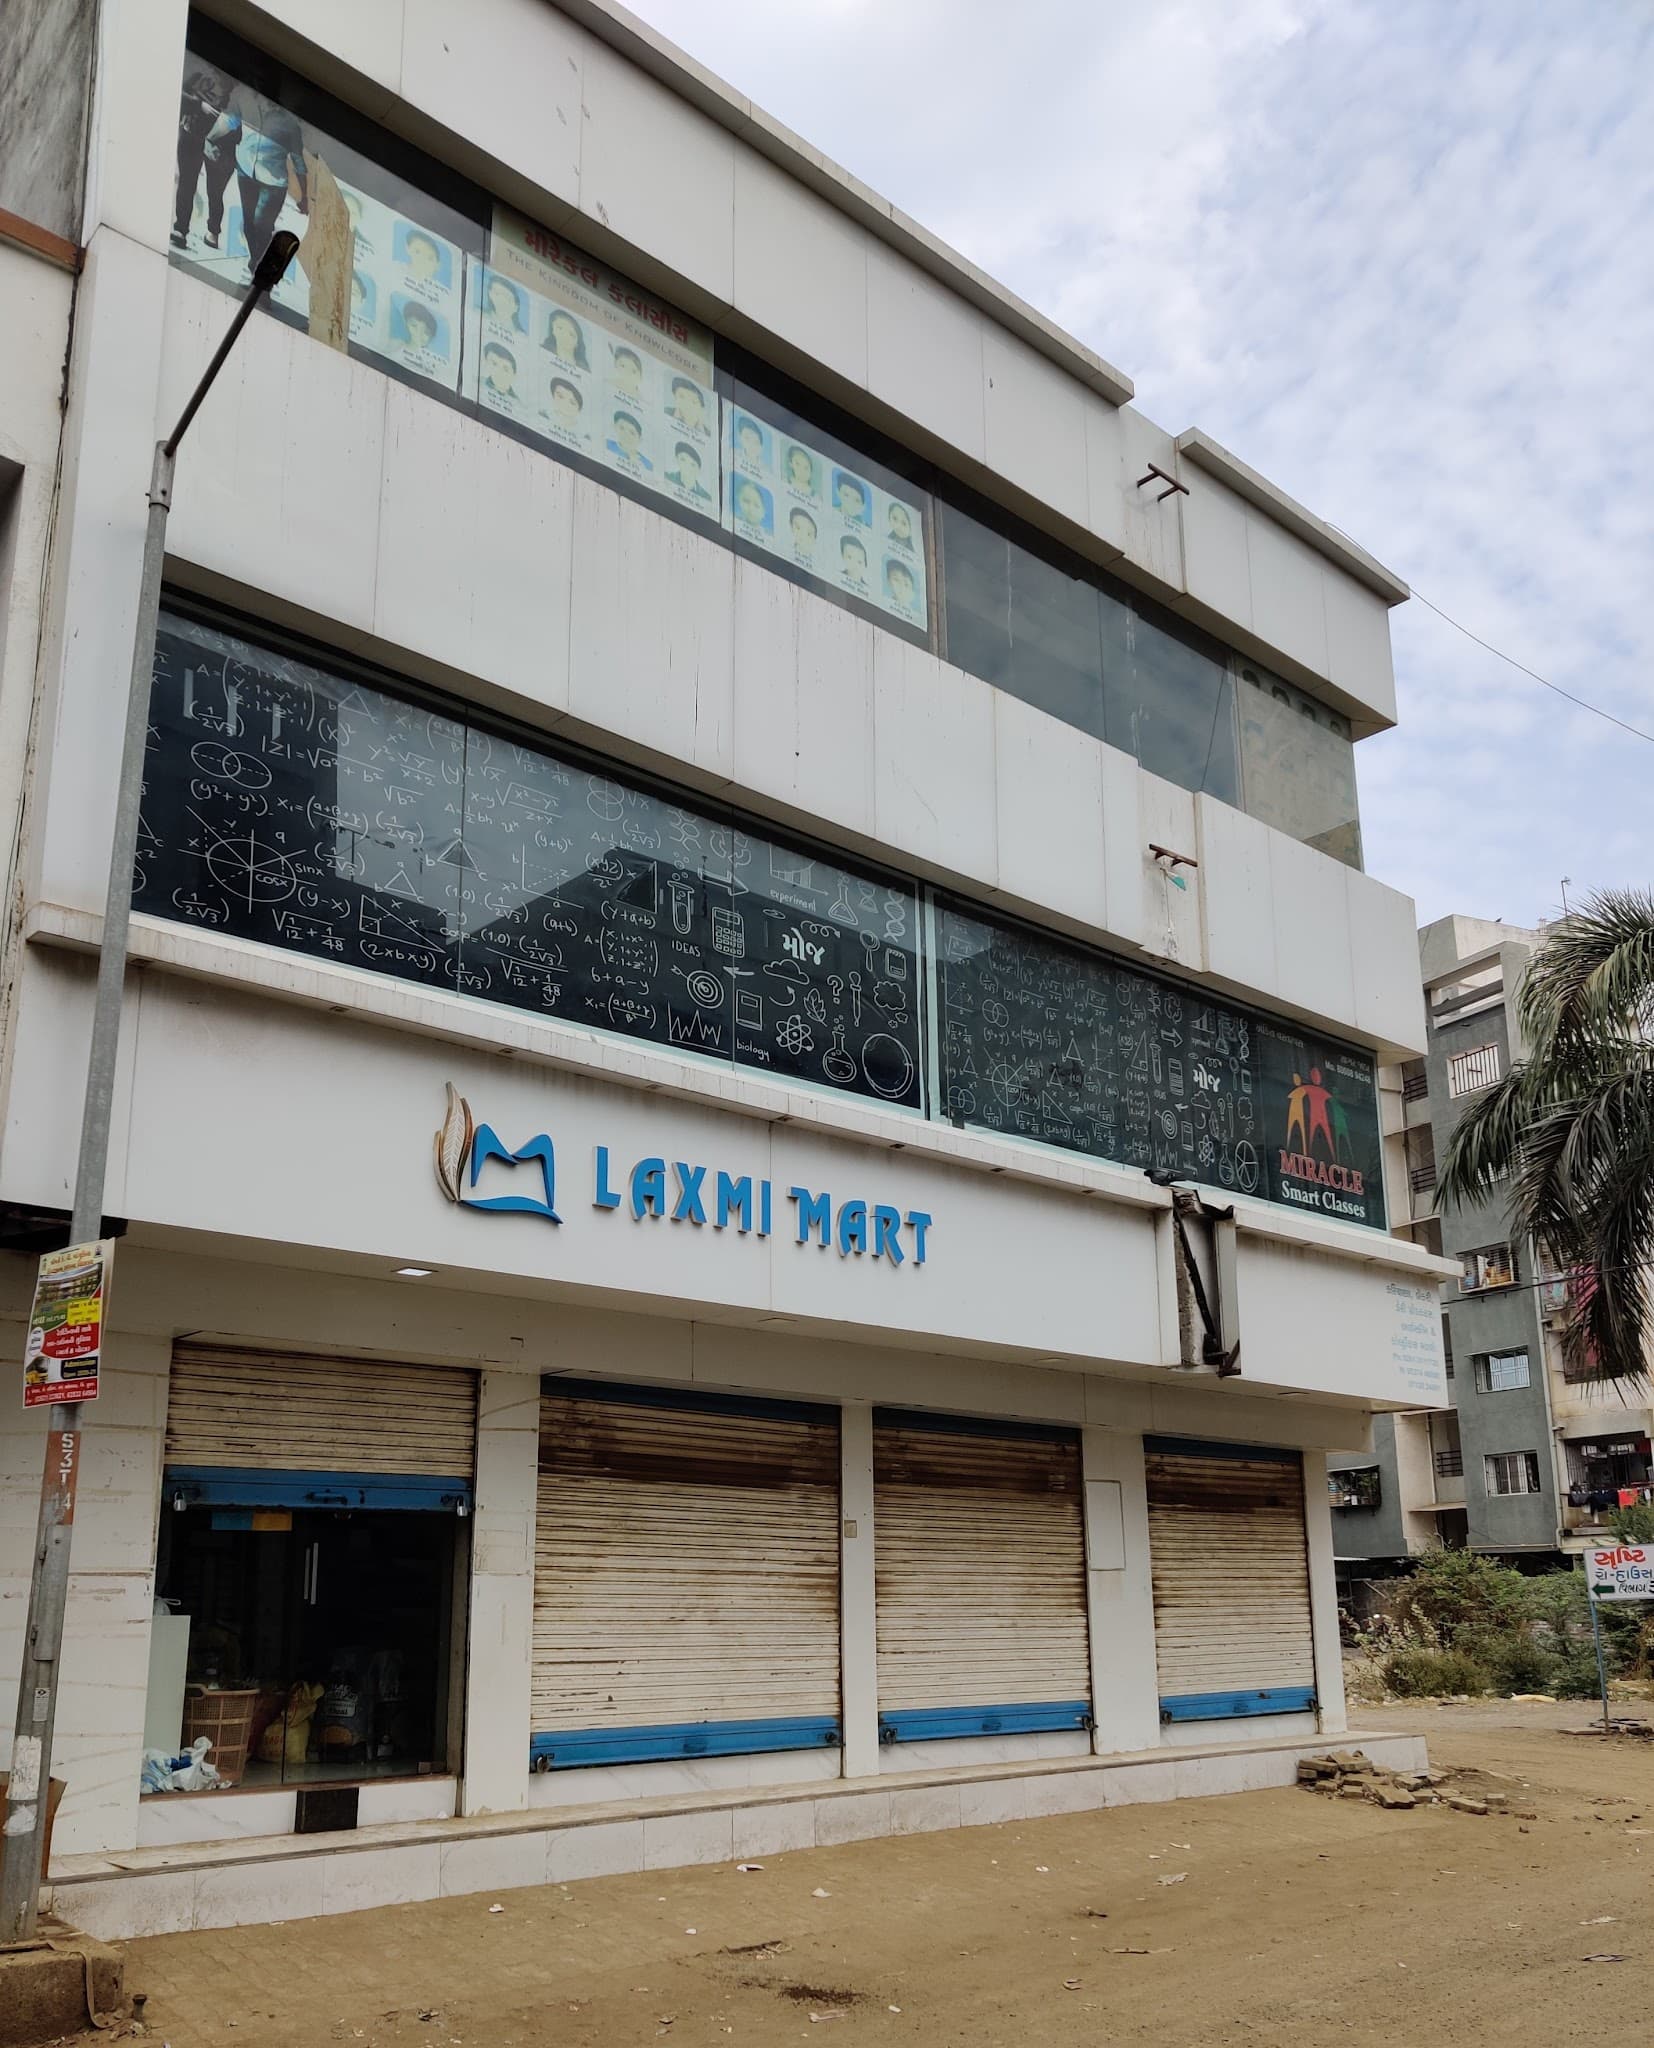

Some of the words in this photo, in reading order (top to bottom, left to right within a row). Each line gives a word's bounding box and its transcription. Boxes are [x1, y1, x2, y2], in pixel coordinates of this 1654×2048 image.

[507, 248, 533, 271] THE
[769, 888, 816, 912] experiment
[672, 940, 701, 957] IDEAS
[736, 1039, 770, 1062] biology
[1279, 1149, 1364, 1195] MIRACLE
[592, 1146, 772, 1237] LAXMI
[786, 1186, 932, 1266] MART
[1282, 1180, 1320, 1206] Smart
[1322, 1192, 1366, 1218] Classes
[1594, 1546, 1646, 1570] સૃષ્ટિ
